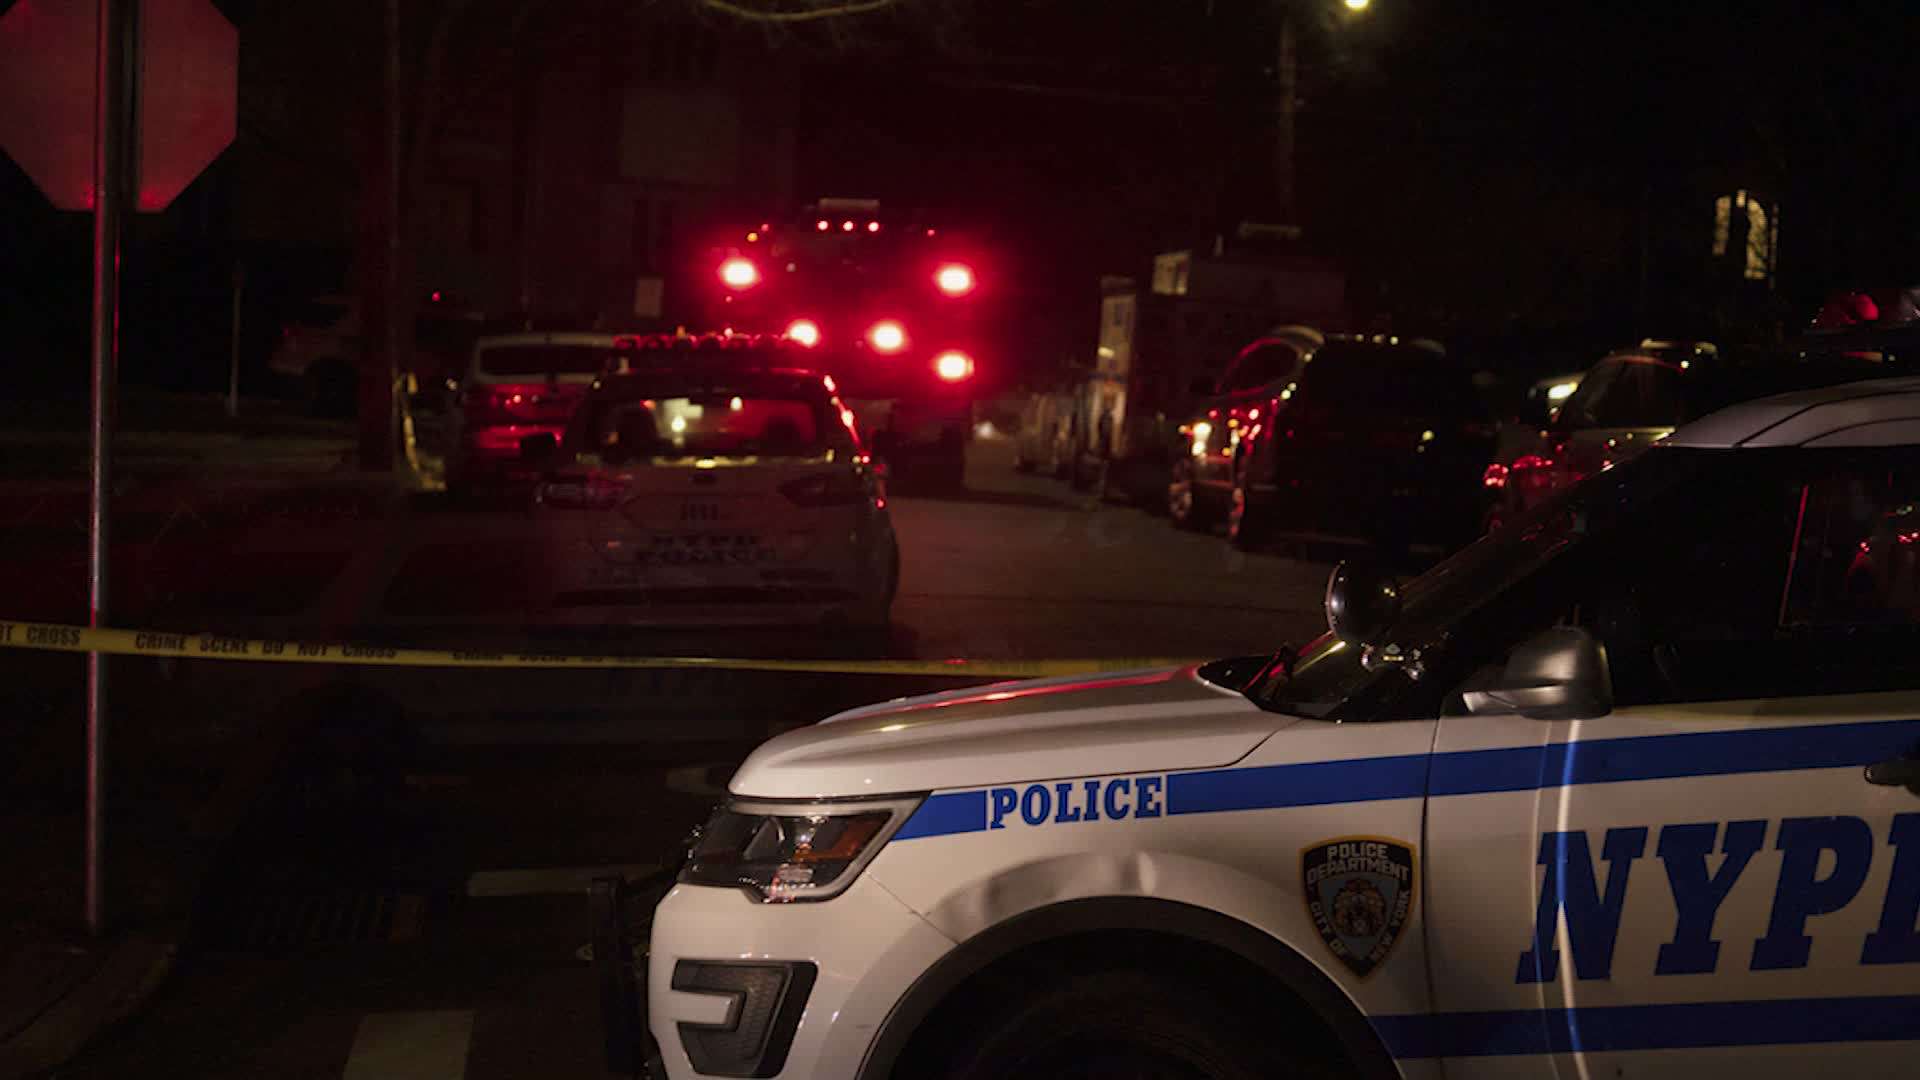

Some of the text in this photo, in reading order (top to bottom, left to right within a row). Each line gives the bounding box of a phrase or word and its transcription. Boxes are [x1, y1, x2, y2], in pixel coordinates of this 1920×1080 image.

[26, 624, 81, 644] CROSS
[135, 631, 186, 651] CRIME
[990, 776, 1162, 830] POLICE
[1327, 842, 1389, 861] POLICE
[1306, 857, 1410, 882] DEPARTMENT
